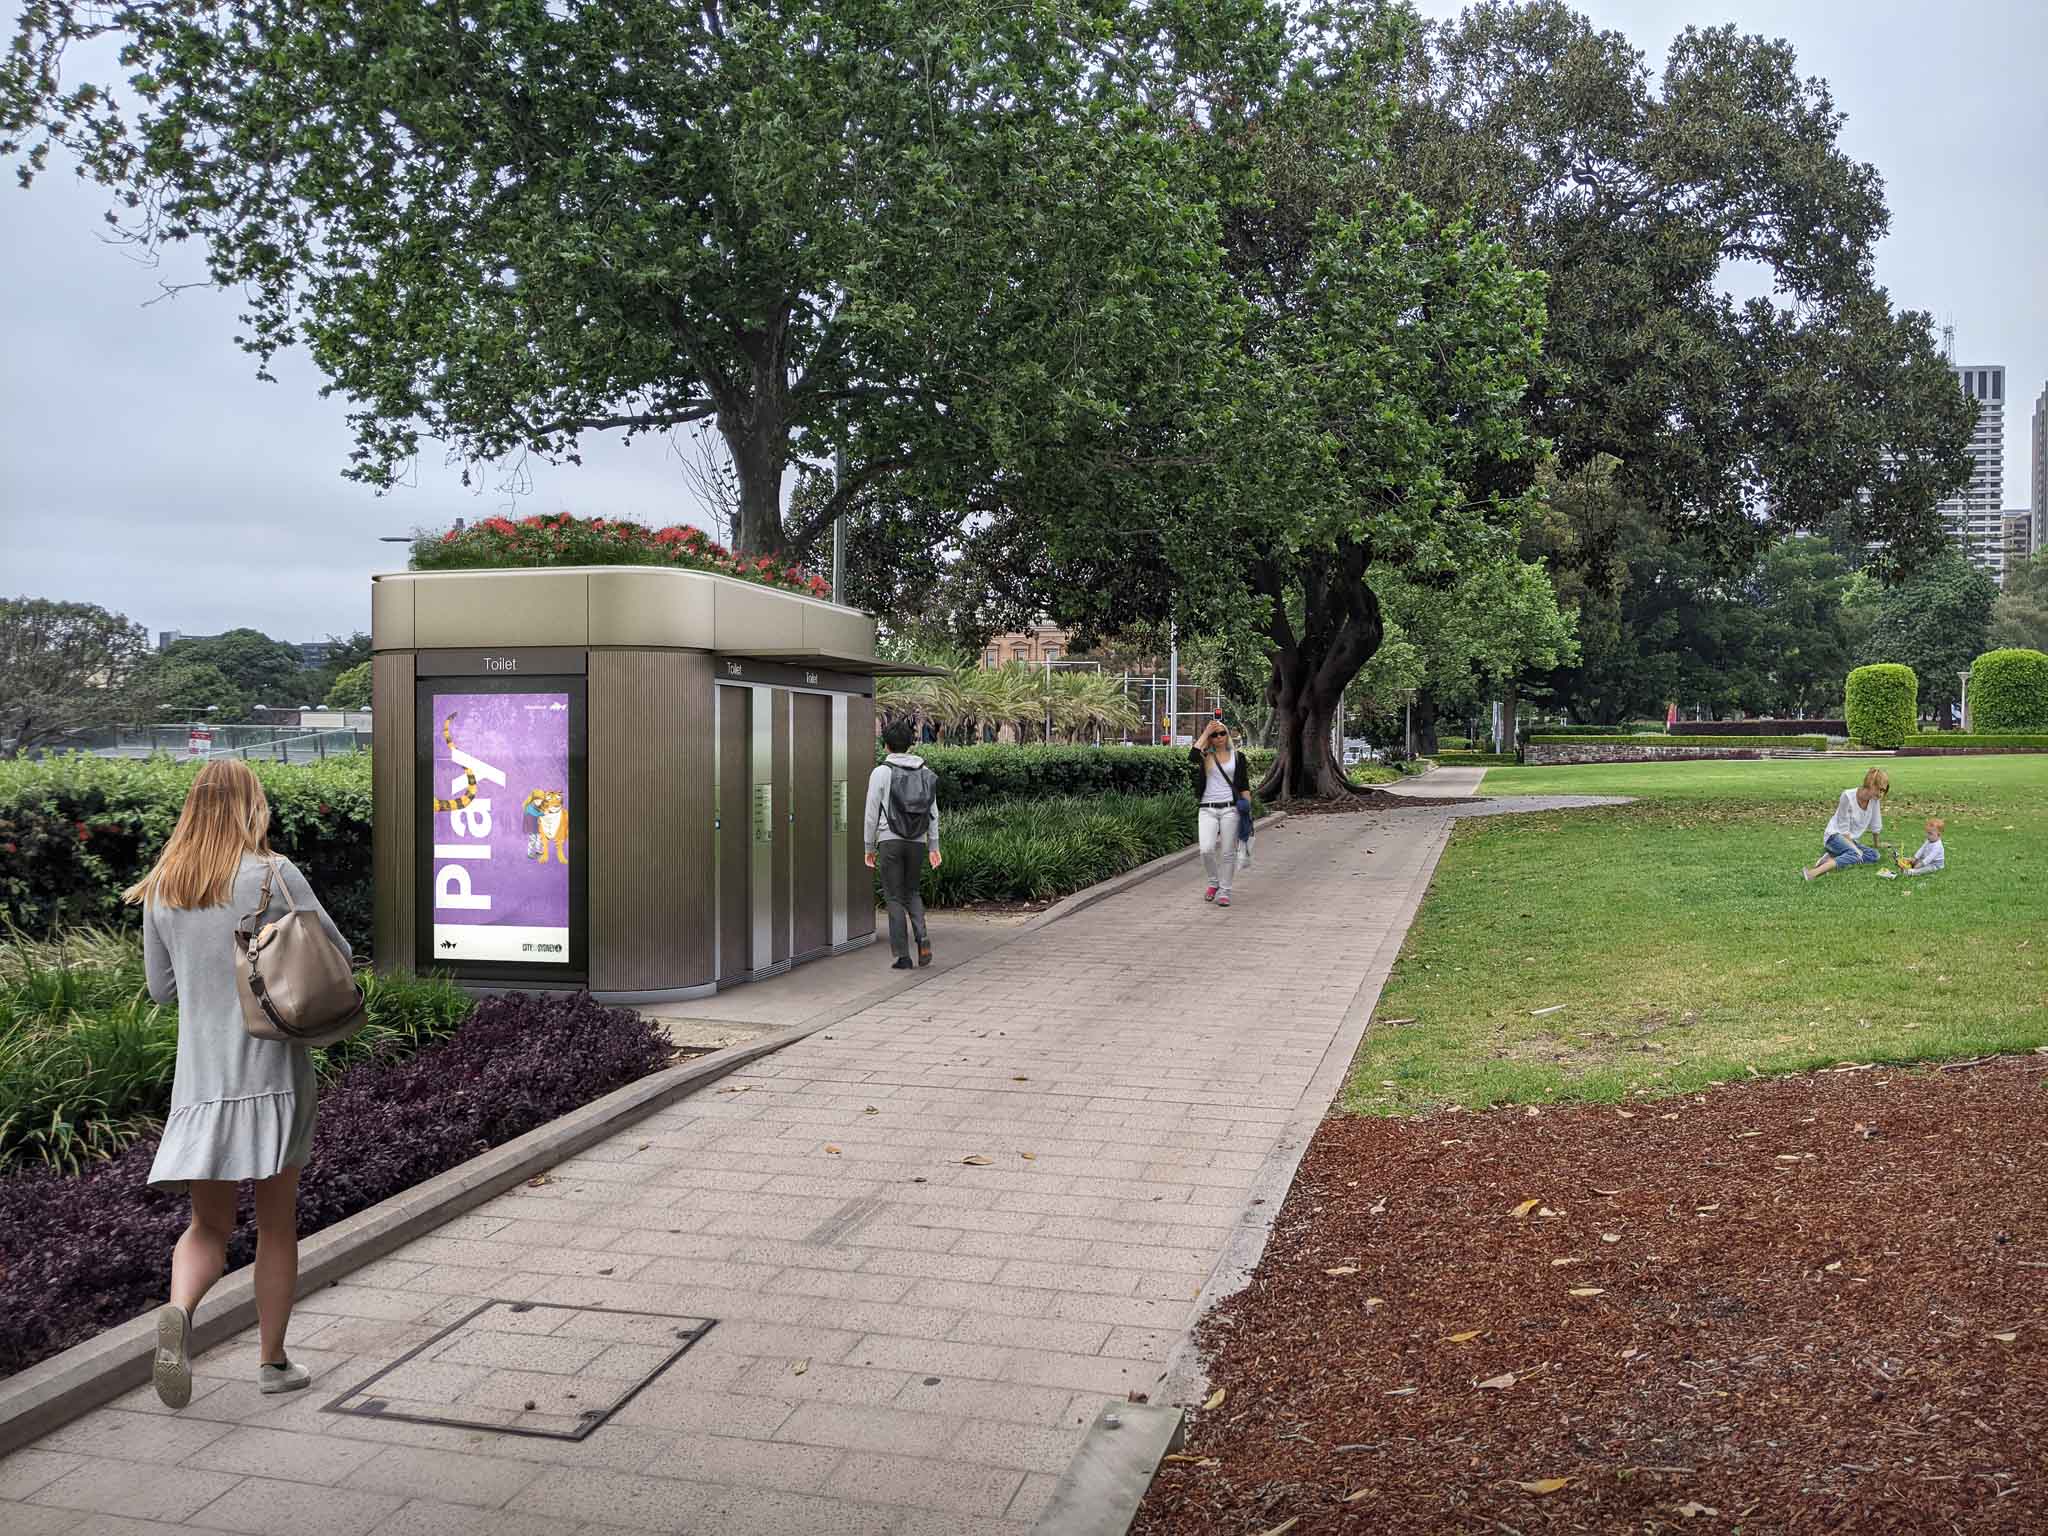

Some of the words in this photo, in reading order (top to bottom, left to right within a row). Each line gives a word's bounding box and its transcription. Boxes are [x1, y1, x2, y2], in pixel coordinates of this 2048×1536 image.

[483, 657, 516, 671] Toilet
[727, 661, 742, 675] Toilet
[434, 749, 506, 910] Play
